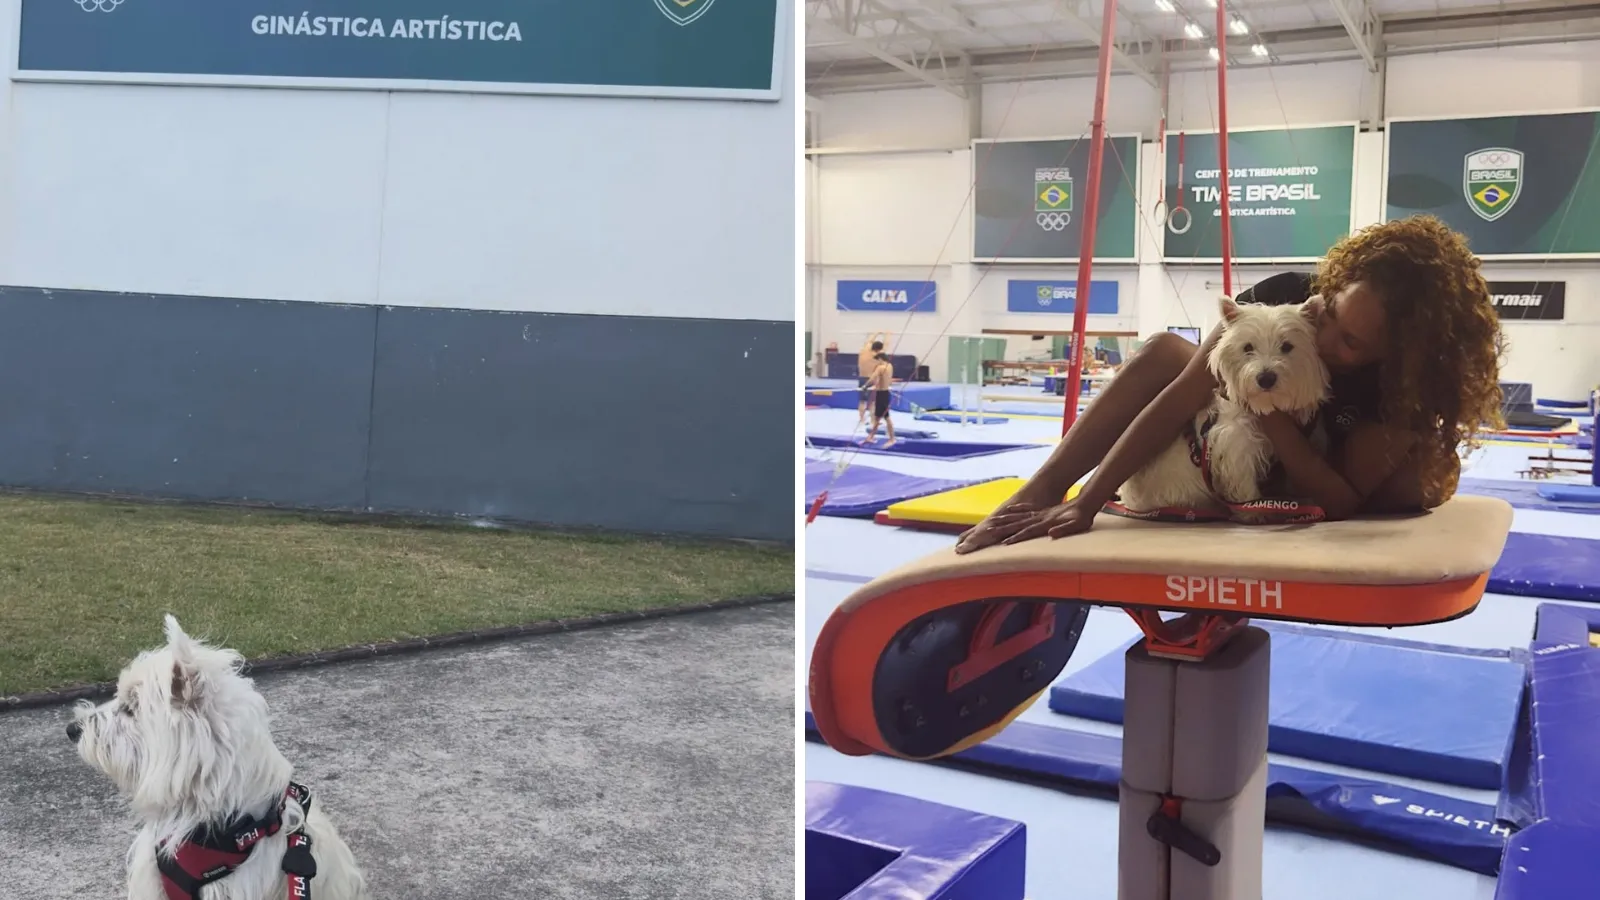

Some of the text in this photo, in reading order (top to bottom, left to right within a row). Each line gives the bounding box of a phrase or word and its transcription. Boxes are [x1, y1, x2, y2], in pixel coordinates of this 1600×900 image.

[251, 11, 522, 42] GINÁSTICA ARTÍSTICA
[1195, 166, 1319, 179] CENTO DE TREINAMENTO
[1471, 169, 1516, 180] BRASIL
[1246, 183, 1321, 201] BRASIL
[1213, 207, 1255, 217] GIÁSTICA
[862, 289, 908, 303] CAIXA
[1242, 500, 1299, 510] FLAMENGO
[1165, 574, 1283, 609] SPIETH
